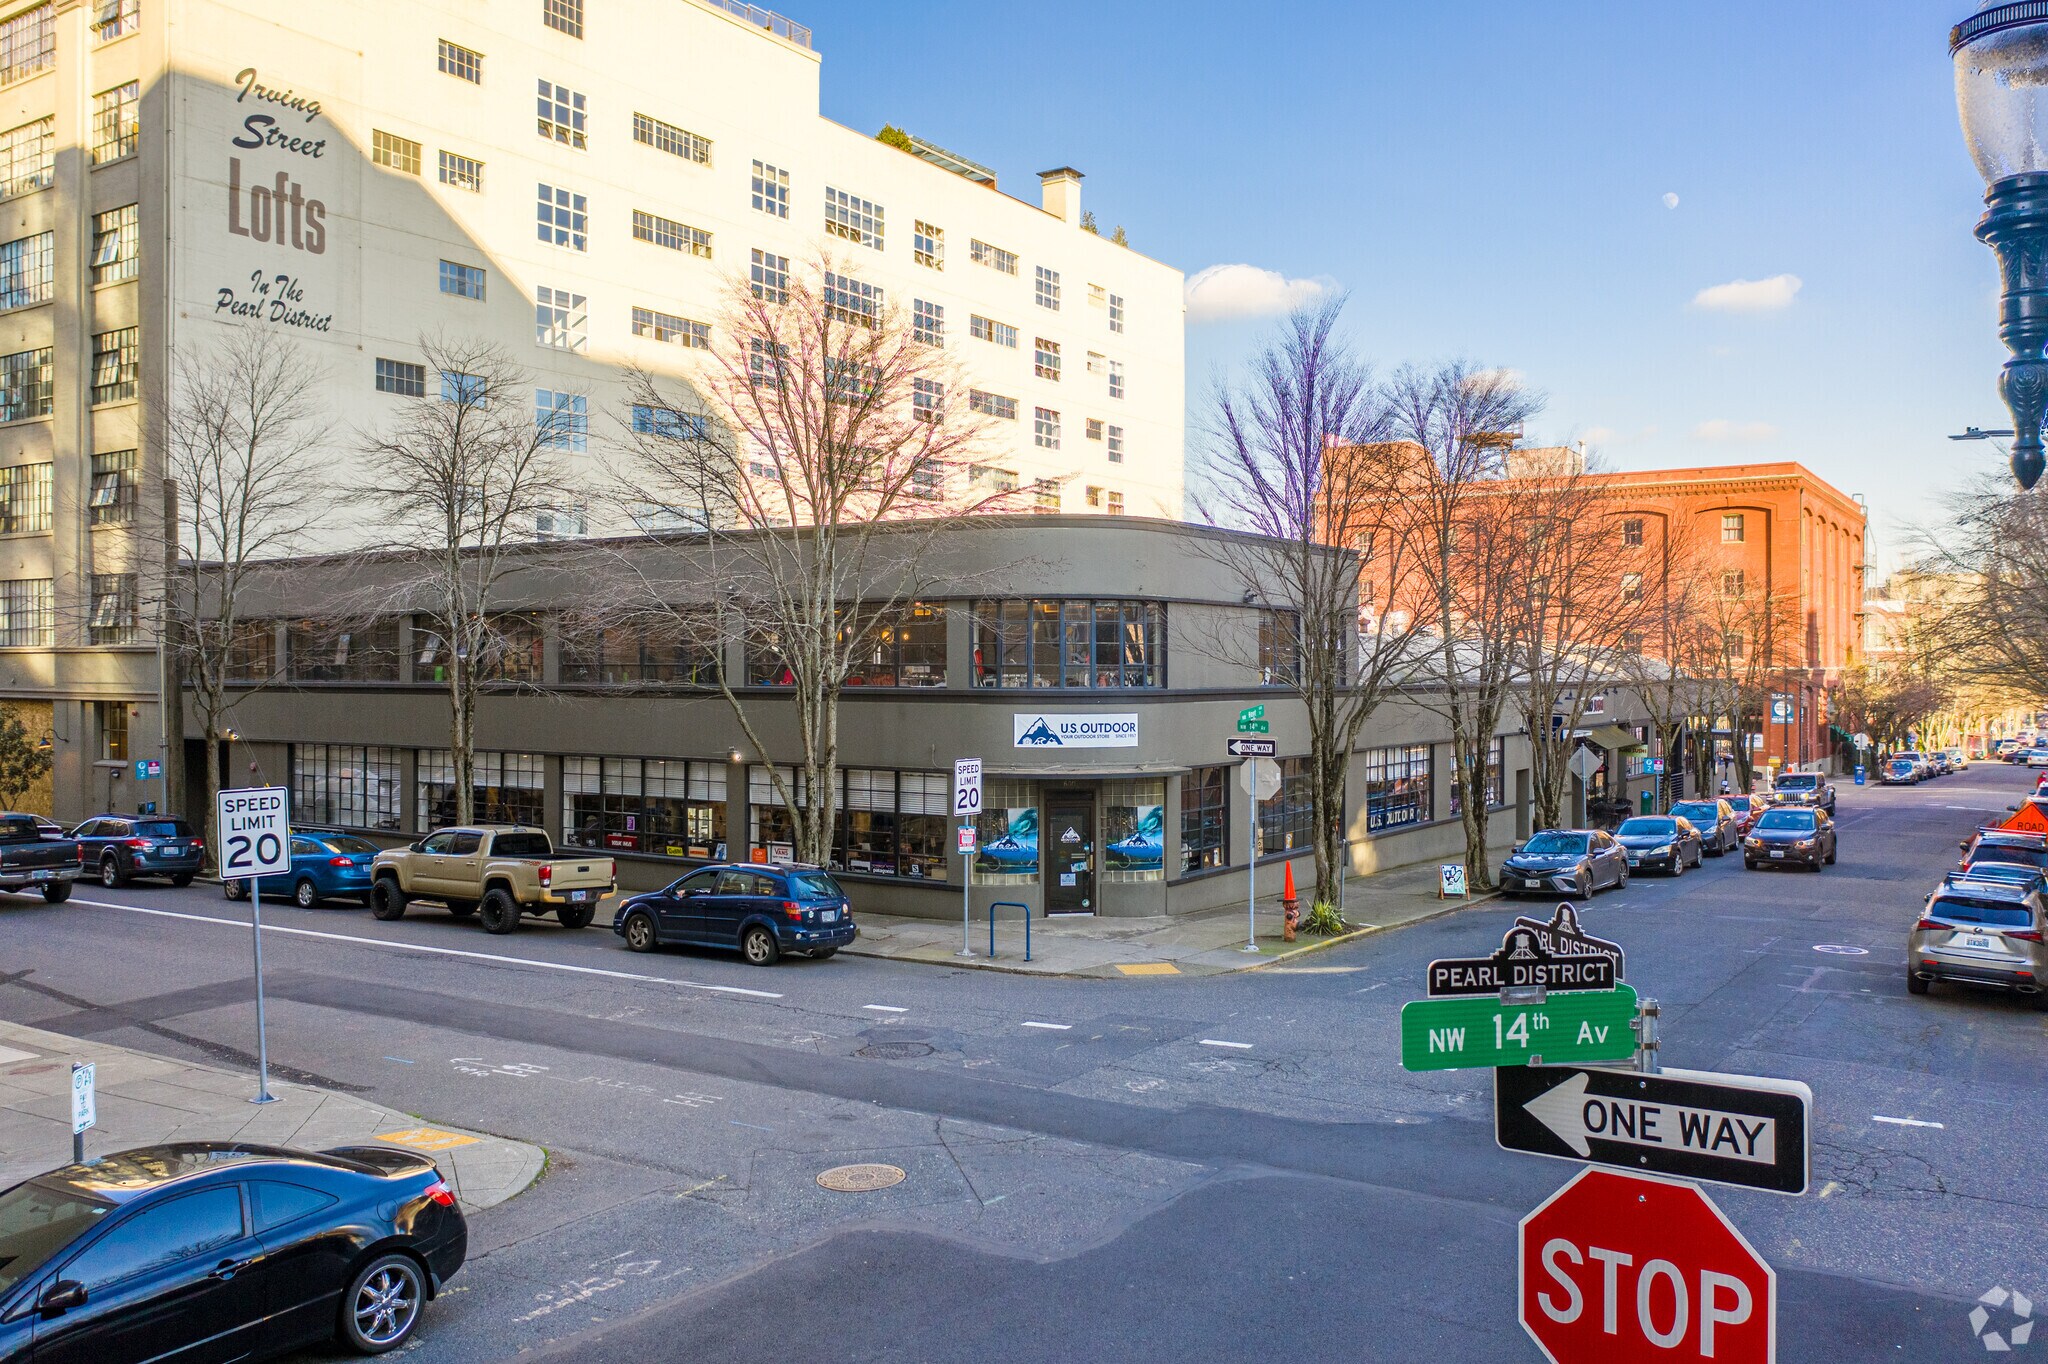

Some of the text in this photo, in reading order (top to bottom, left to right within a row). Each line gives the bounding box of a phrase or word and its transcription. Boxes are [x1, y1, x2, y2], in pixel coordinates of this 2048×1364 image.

[235, 67, 322, 122] Irving
[232, 114, 326, 158] Street
[228, 156, 326, 255] Lofts
[251, 269, 303, 302] In The
[215, 288, 332, 332] Pearl District
[1060, 722, 1136, 734] U.S. OUTDOOR
[1241, 744, 1271, 752] ONE WAY
[958, 764, 979, 775] SPEED
[959, 776, 977, 786] LIMIT
[225, 796, 281, 812] SPEED
[957, 787, 979, 809] 20
[231, 814, 276, 831] LIMIT
[2017, 822, 2044, 832] ROAD
[227, 833, 282, 868] 20
[611, 839, 632, 847] YAKMA
[774, 847, 789, 856] VANS
[1435, 962, 1608, 988] PEARL DISTRICT
[1429, 1012, 1609, 1053] NW 14th Av
[1583, 1099, 1767, 1157] ONE WAY
[1537, 1237, 1753, 1359] STOP
